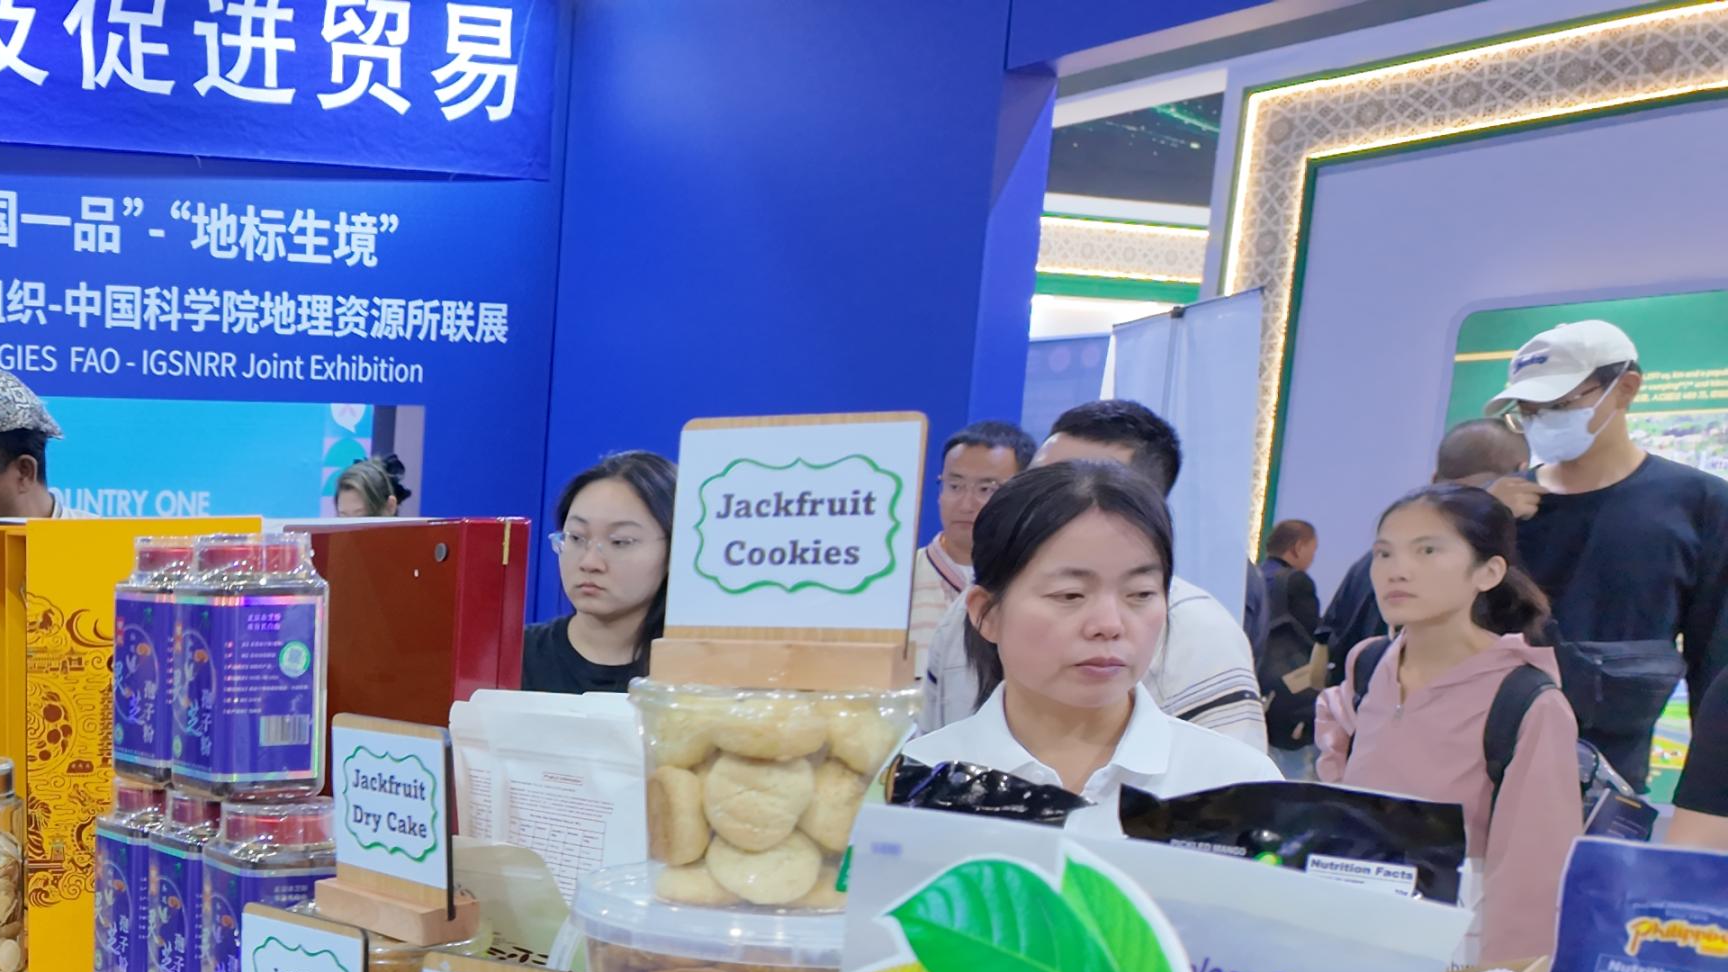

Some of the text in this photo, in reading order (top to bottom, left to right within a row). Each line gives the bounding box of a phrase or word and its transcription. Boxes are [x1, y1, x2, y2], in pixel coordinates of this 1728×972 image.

[69, 345, 121, 374] FAO
[141, 348, 238, 379] IGSNRR
[240, 351, 305, 382] Joint
[310, 353, 424, 385] Exhibition
[48, 486, 211, 517] OUNTRY ONE
[716, 489, 877, 520] Jackfruit
[723, 539, 861, 567] Cookies
[352, 768, 427, 802] Jackfruit
[352, 804, 428, 839] Dry Cake
[1309, 857, 1414, 881] Nutrition Facts
